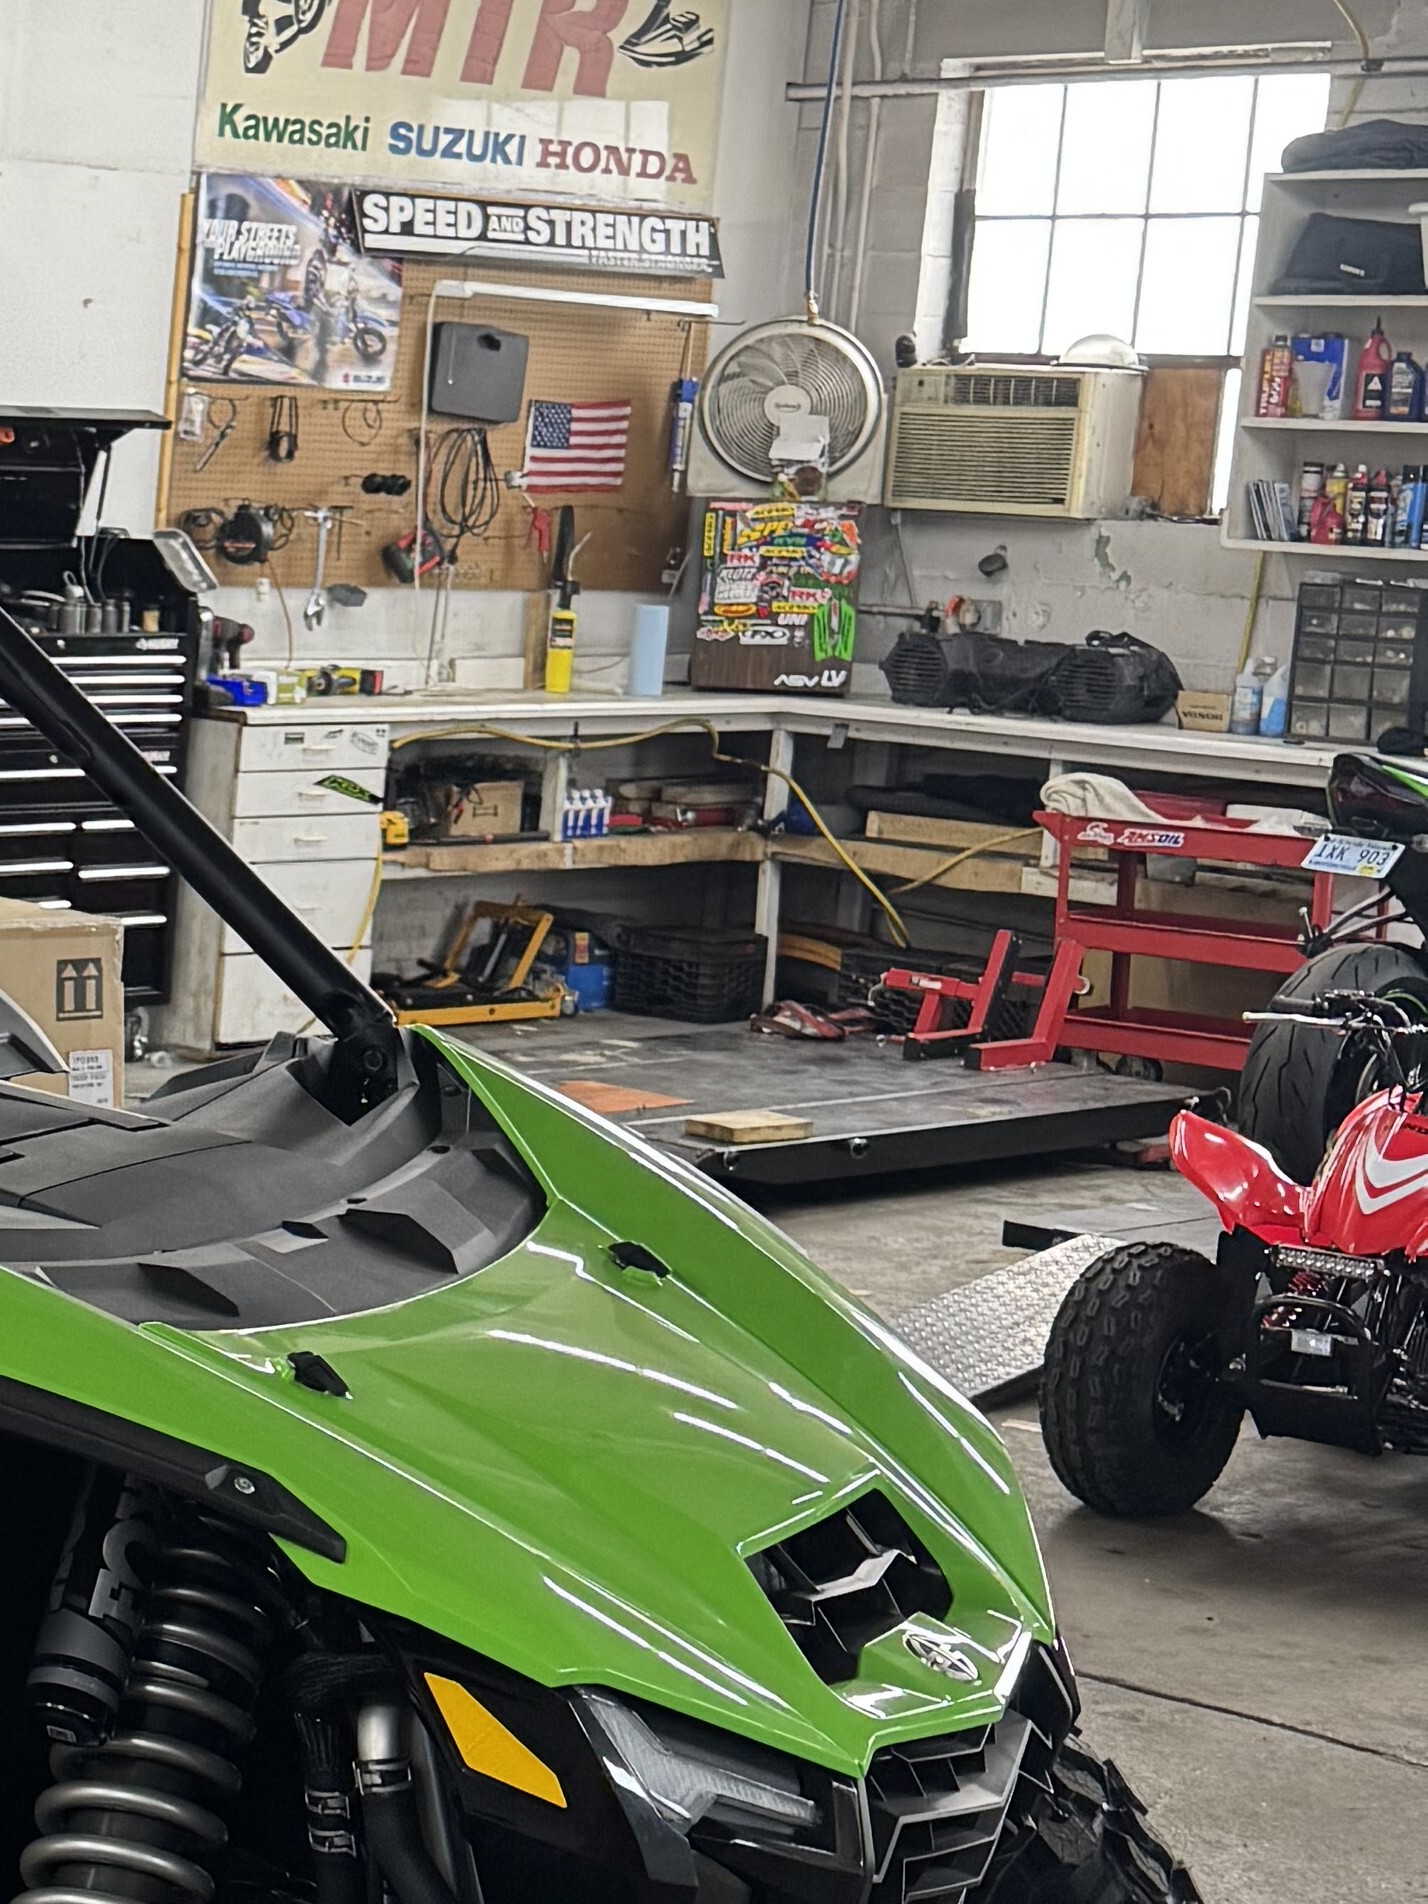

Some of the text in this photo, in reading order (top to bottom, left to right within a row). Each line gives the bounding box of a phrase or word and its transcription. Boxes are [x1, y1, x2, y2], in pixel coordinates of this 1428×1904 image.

[217, 102, 698, 185] Kawasaki SUZUKI HONDA
[362, 193, 711, 258] SPEED AND STRENGTH
[1122, 828, 1184, 847] AMSOIL
[1357, 848, 1389, 867] 903
